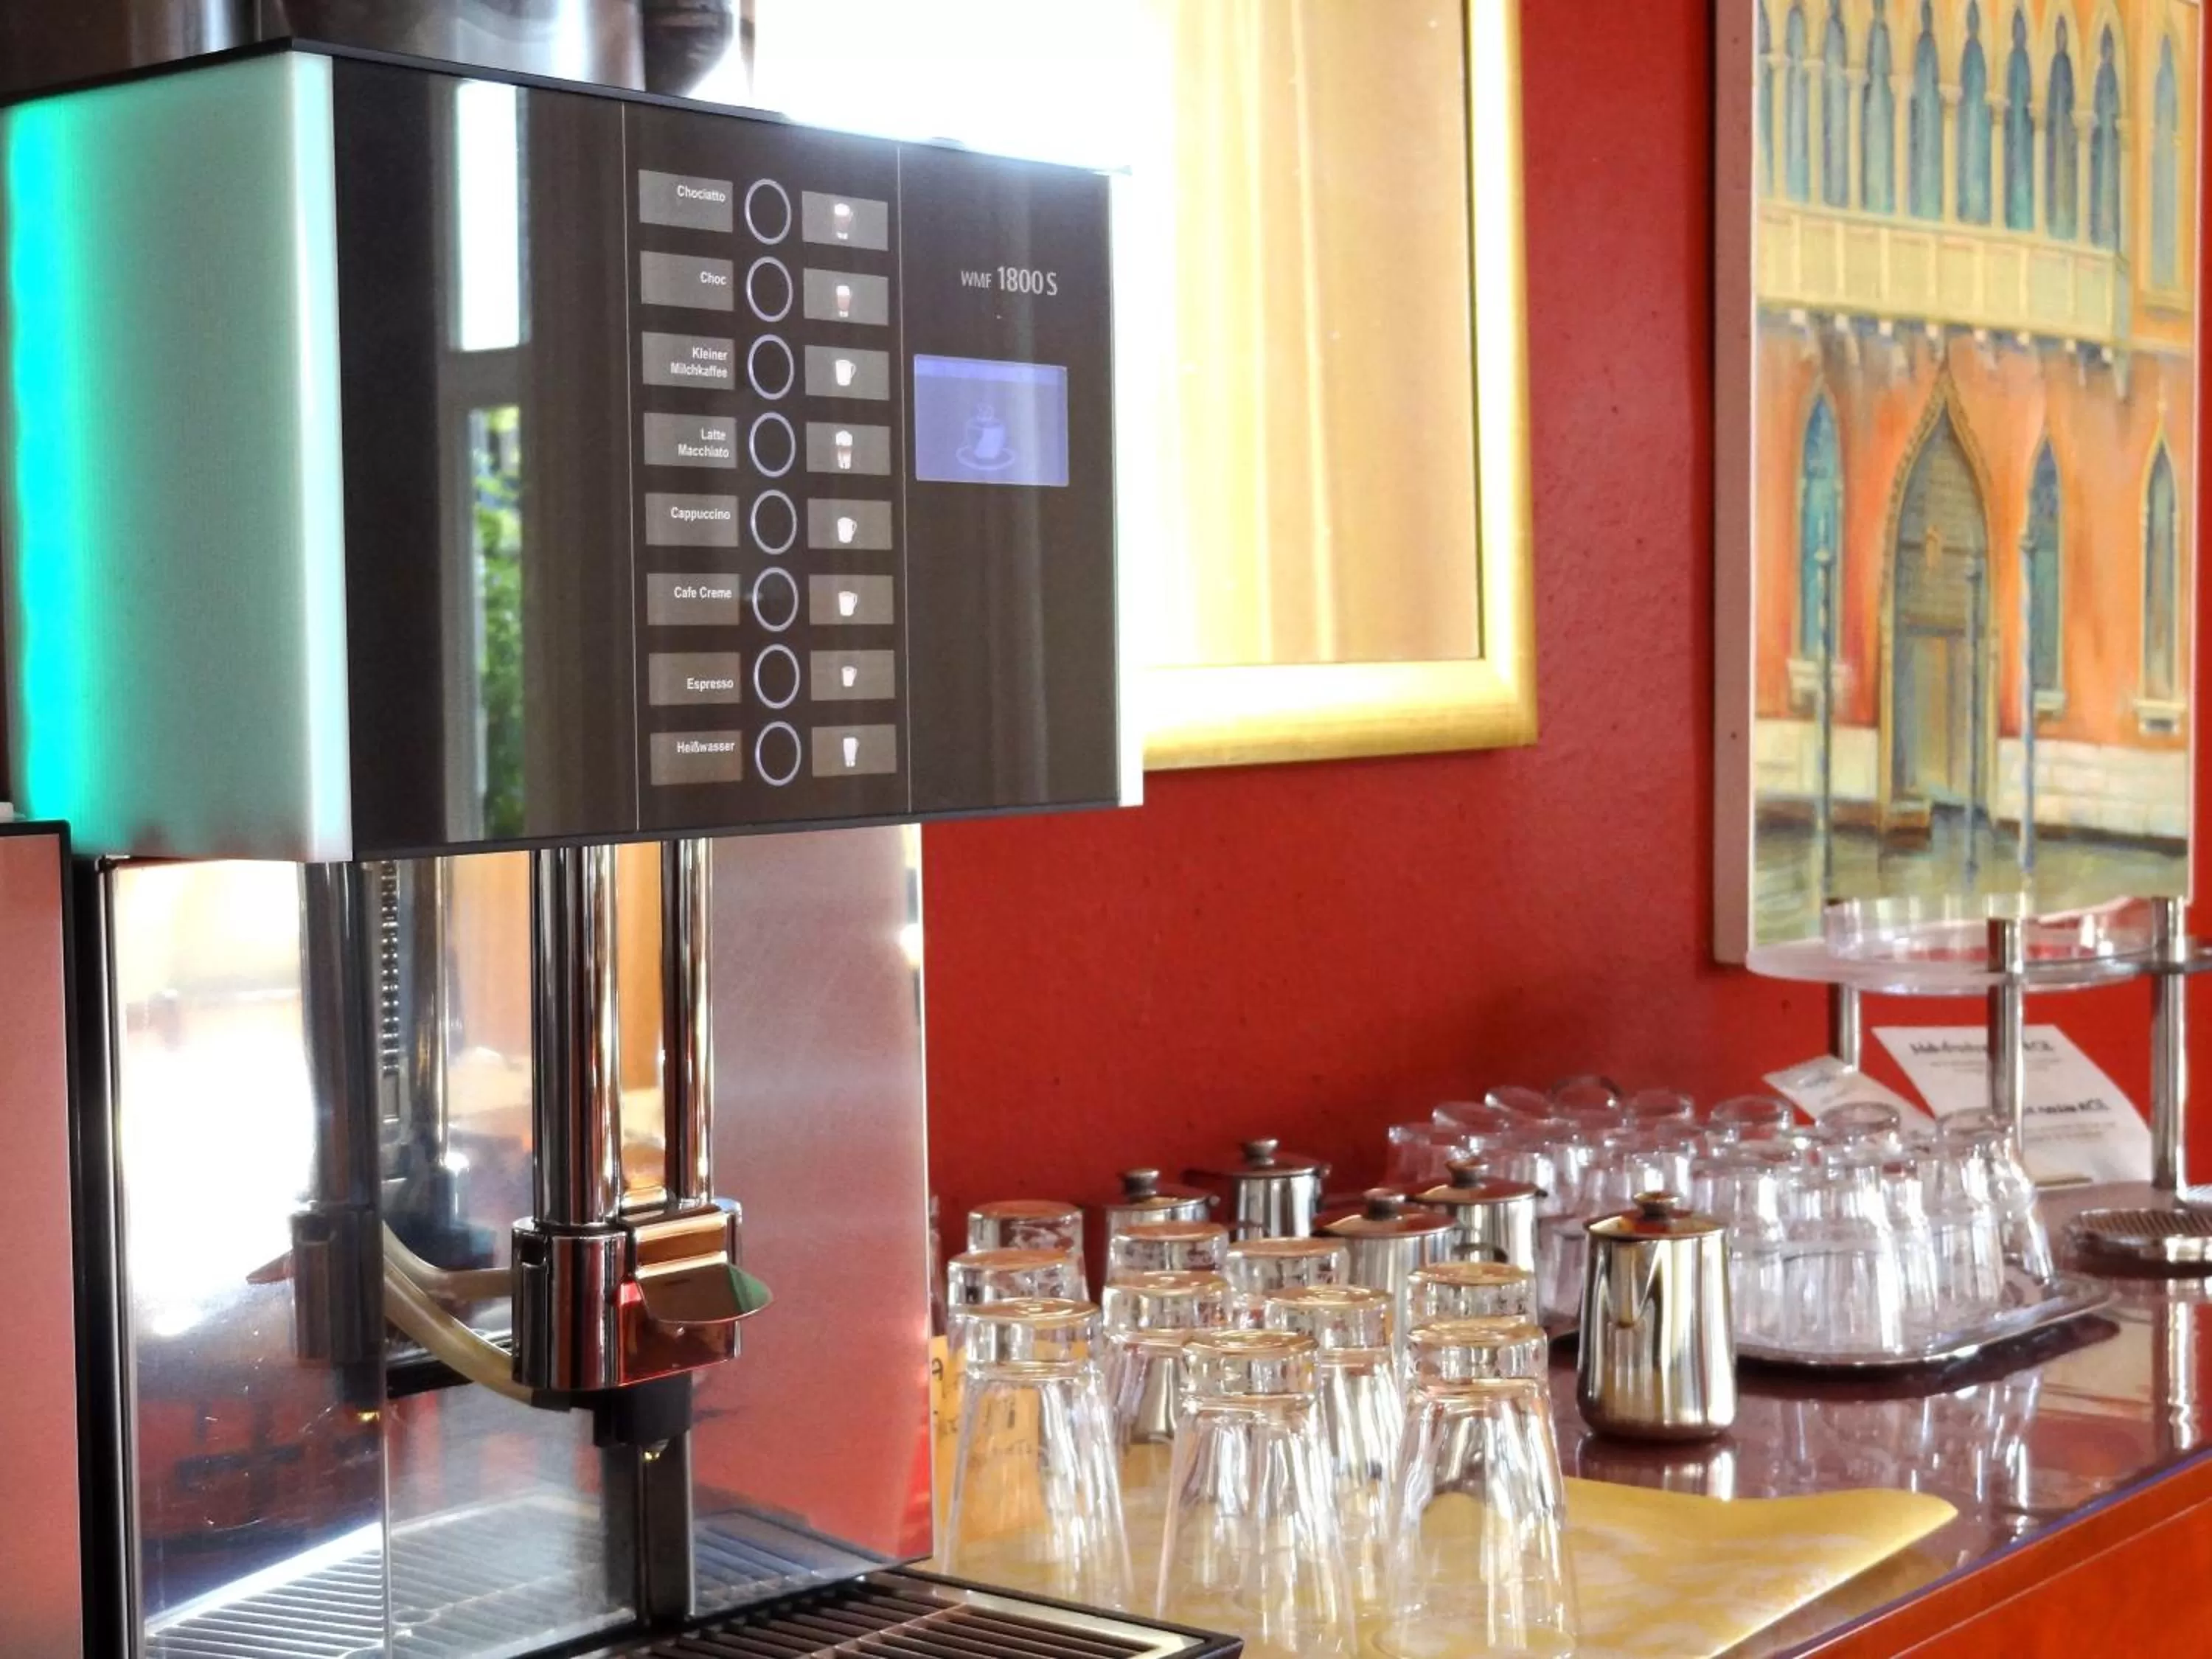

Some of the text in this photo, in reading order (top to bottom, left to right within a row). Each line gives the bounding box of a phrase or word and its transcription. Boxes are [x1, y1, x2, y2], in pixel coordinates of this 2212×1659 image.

[676, 184, 726, 203] Chociatto
[700, 271, 726, 285] Choc
[960, 265, 1058, 296] WMF 1800 S
[692, 346, 728, 361] Kleiner
[670, 361, 728, 378] Milchkaffee
[700, 428, 726, 441] Latte
[678, 443, 729, 458] Macchiato
[670, 506, 731, 522] Cappuccino
[673, 586, 731, 599] Cafe Creme
[686, 677, 734, 693] Espresso
[677, 740, 735, 754] Heißwasser
